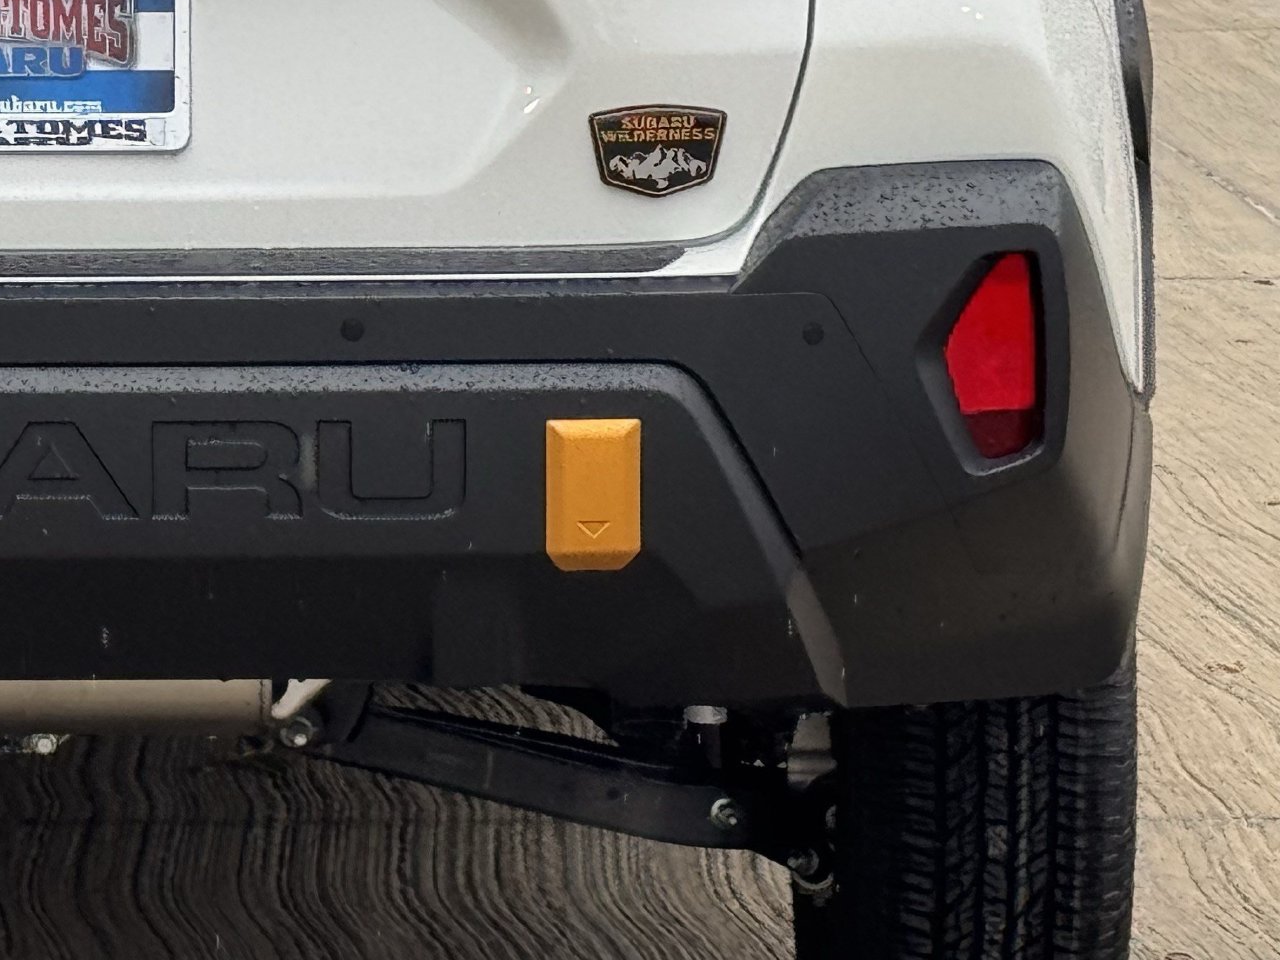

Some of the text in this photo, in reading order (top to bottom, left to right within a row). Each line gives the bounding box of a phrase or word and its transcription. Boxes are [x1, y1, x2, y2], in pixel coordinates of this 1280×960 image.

[621, 115, 696, 130] SUBARU
[6, 119, 148, 143] TOMES
[600, 127, 716, 143] WILDERNESS
